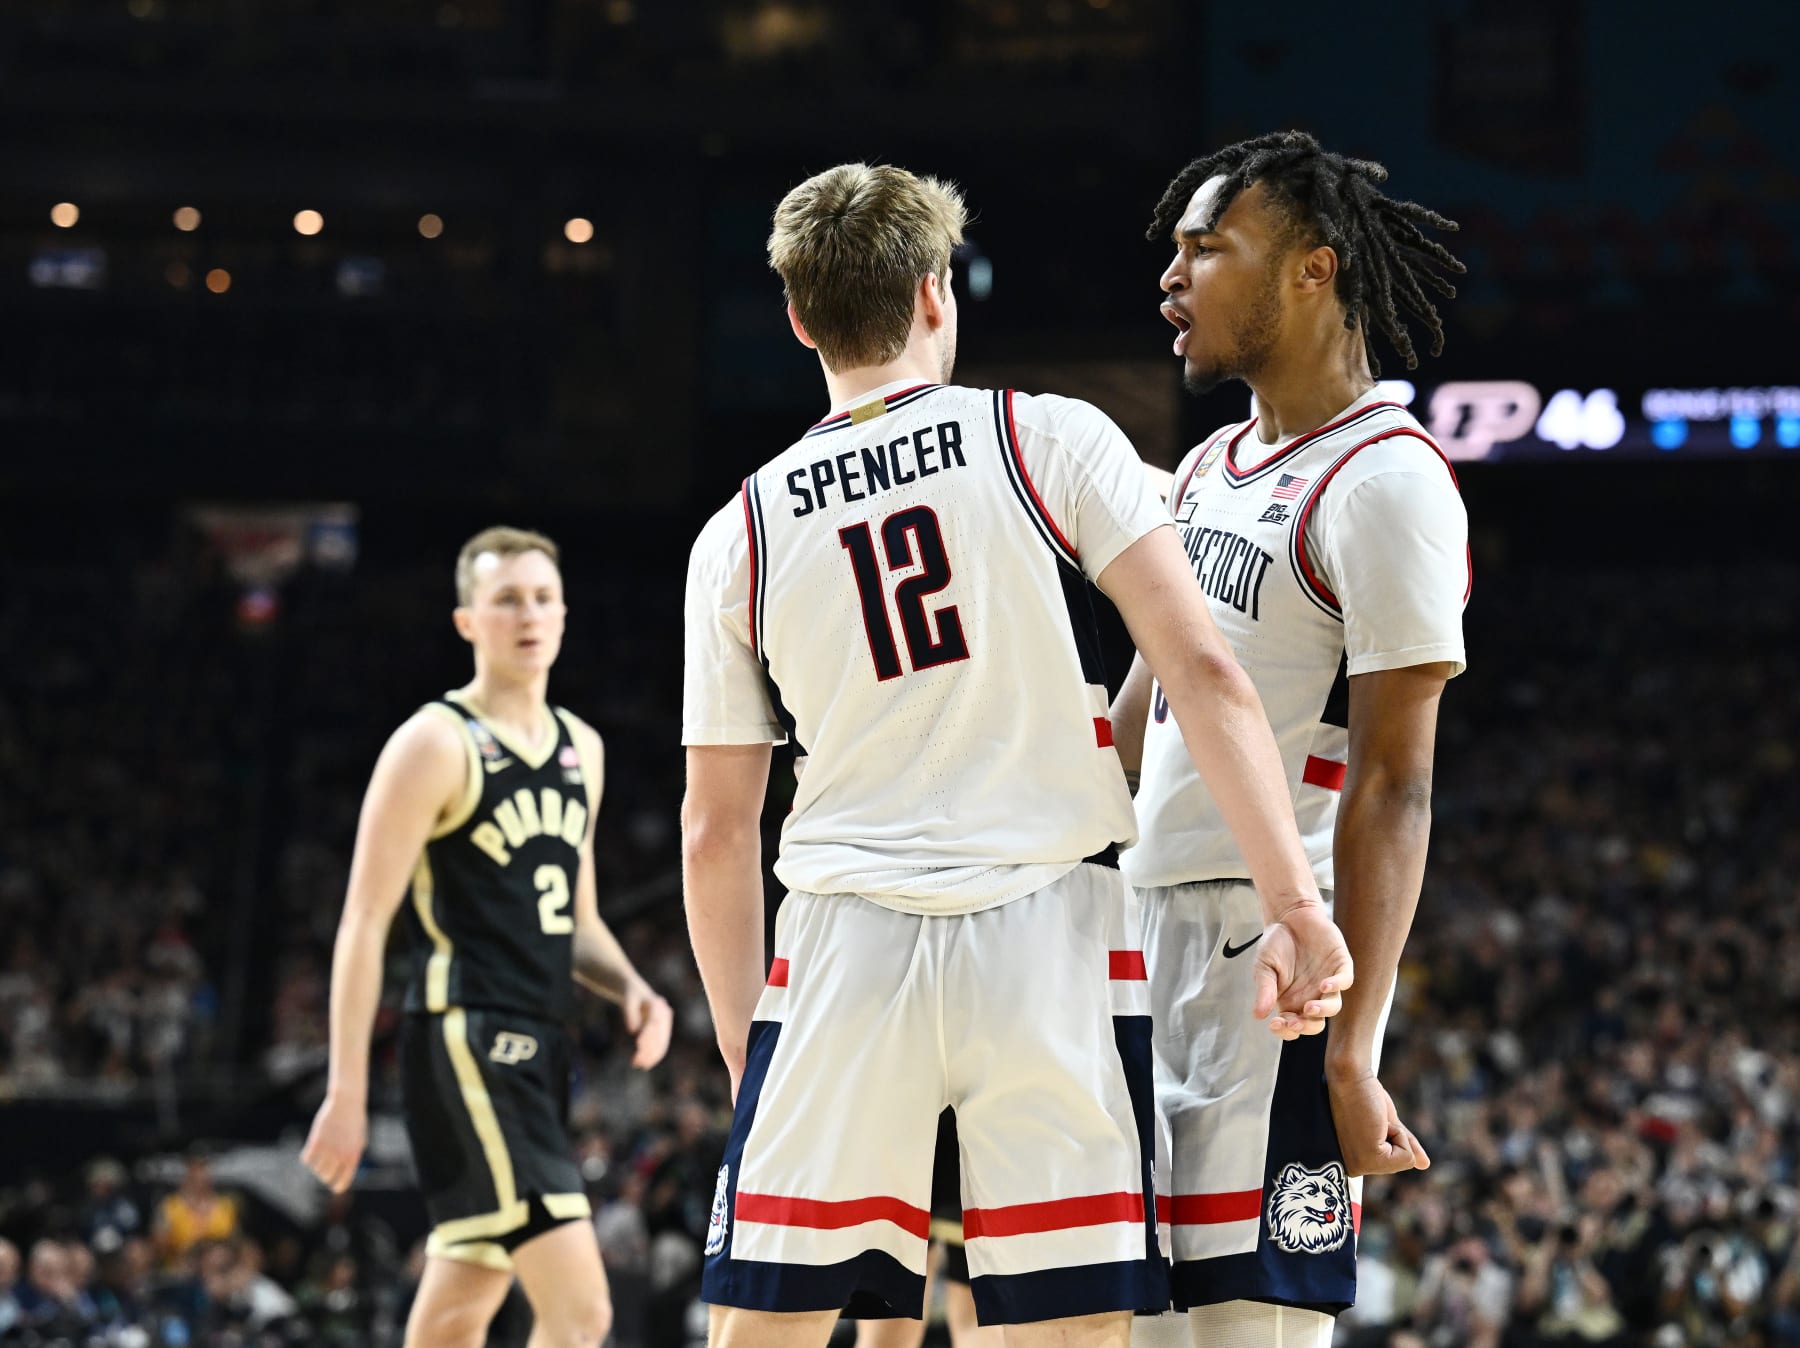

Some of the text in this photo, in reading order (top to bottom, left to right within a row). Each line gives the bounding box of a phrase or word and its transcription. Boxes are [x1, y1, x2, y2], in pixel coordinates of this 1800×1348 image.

[1536, 388, 1626, 450] 46
[786, 420, 967, 518] SPENCER
[1261, 511, 1290, 521] EAST
[1267, 503, 1288, 512] BIG
[838, 505, 970, 682] 12
[1179, 526, 1275, 622] NECTICUT
[533, 864, 574, 934] 2
